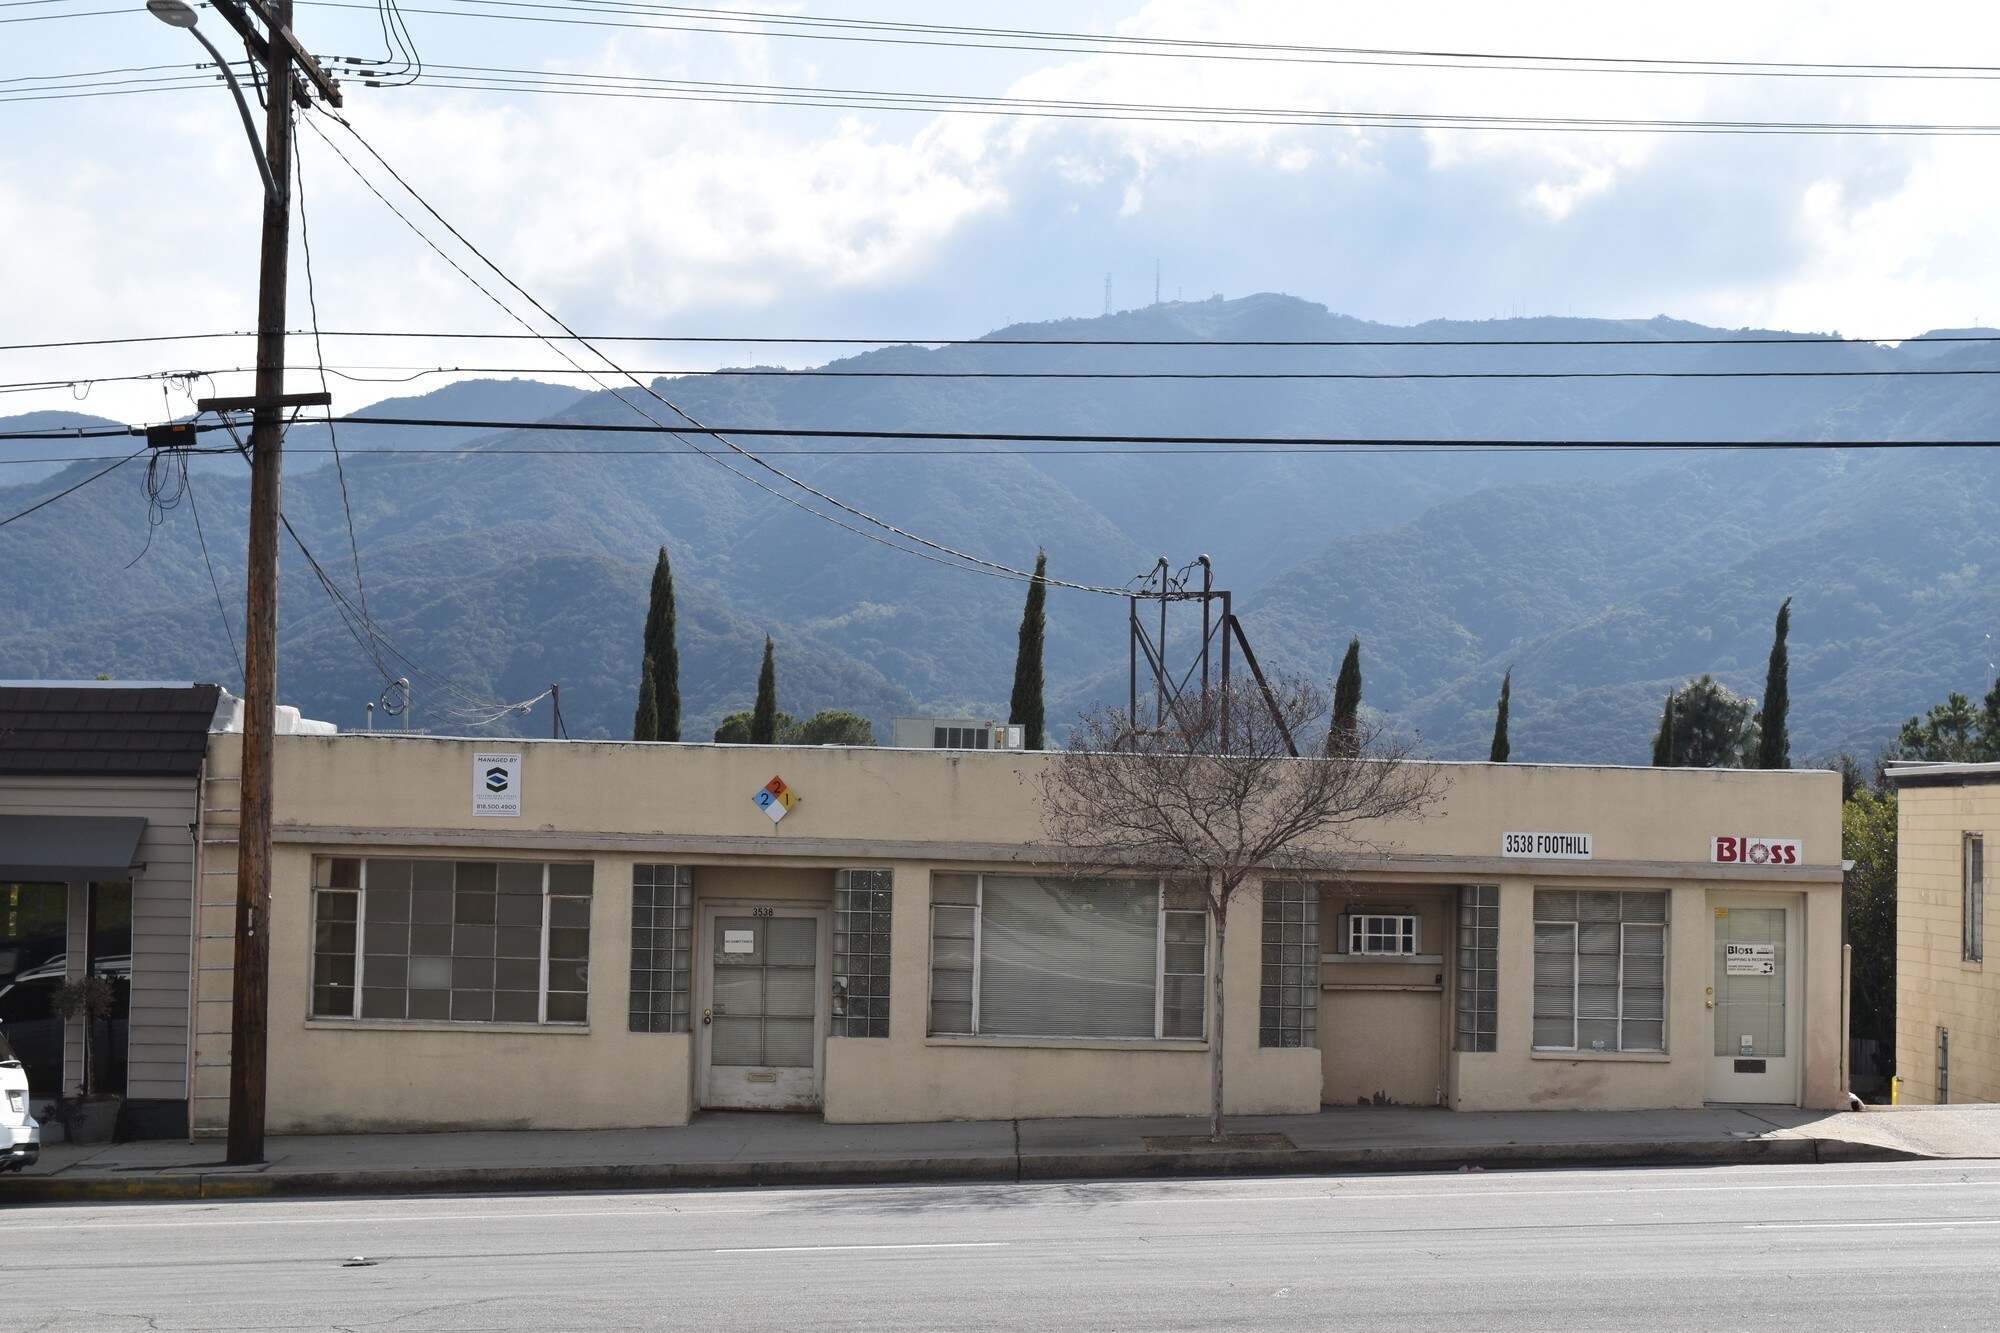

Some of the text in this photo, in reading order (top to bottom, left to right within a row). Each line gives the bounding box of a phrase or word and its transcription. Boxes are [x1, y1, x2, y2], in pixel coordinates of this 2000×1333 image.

[773, 781, 781, 794] 2
[760, 793, 769, 805] 2
[1506, 834, 1589, 854] 3538 FOOTHILL
[1716, 837, 1796, 864] Bloss
[753, 907, 774, 917] 3538
[1728, 946, 1753, 954] Bloss
